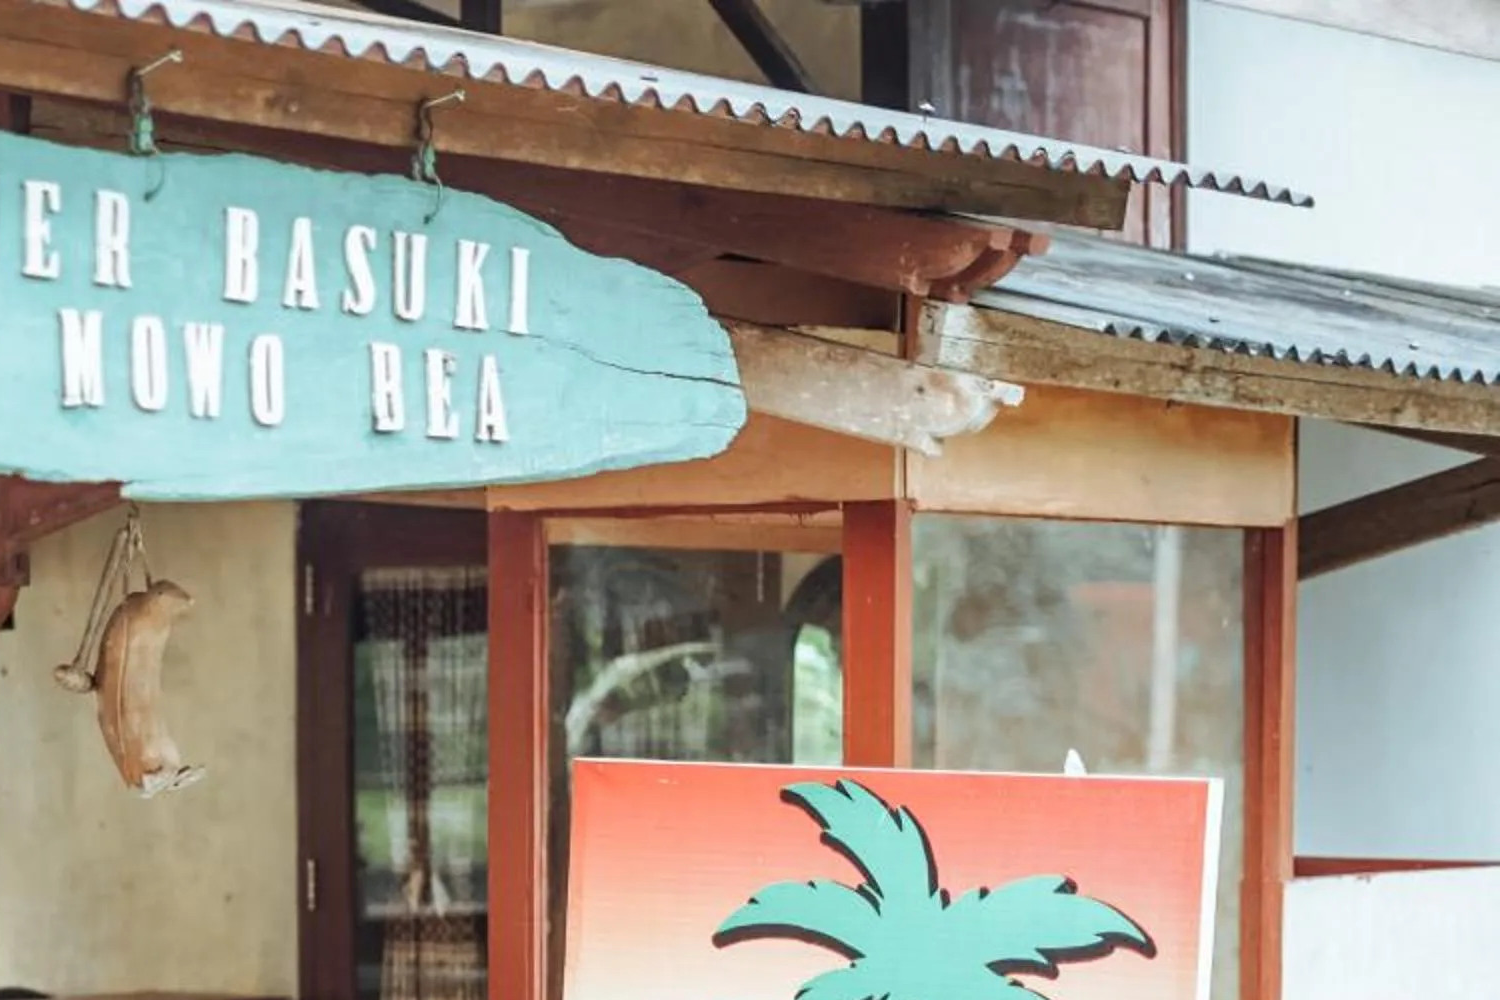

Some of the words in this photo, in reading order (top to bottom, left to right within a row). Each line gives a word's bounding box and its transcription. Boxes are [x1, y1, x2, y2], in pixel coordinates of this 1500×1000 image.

[222, 206, 530, 335] BASUKI
[59, 308, 286, 426] MOWO
[369, 341, 510, 442] BEA
